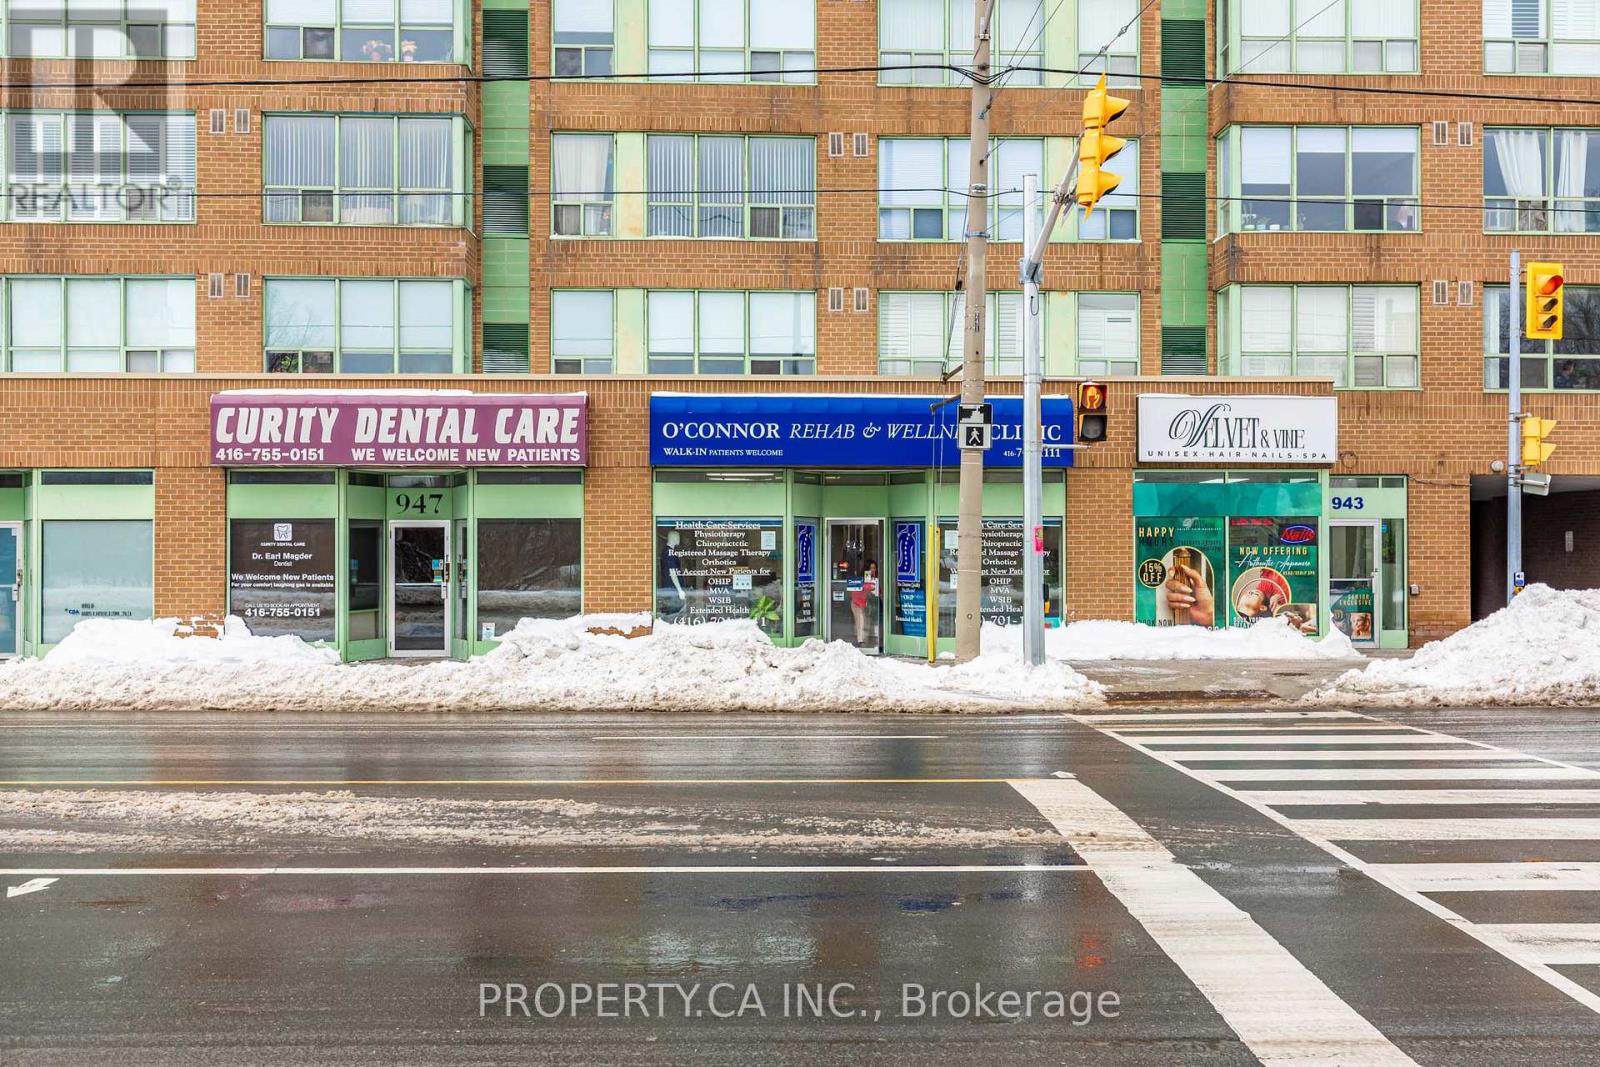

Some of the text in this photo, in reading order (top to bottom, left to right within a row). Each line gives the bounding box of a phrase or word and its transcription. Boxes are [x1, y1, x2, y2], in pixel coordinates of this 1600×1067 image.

[216, 407, 580, 444] CURITY DENTAL CARE
[1168, 403, 1305, 449] VELVET & VINE
[662, 421, 1061, 440] O'CONNOR REHAB & WELLN CLIIC
[216, 448, 324, 461] 416-755-0151
[351, 448, 581, 461] WE WELCOME NEW PATIENTS
[663, 447, 707, 456] WALK-IN
[395, 494, 443, 514] 947
[1331, 496, 1364, 510] 943
[694, 530, 746, 539] Physiotherapy
[1138, 526, 1175, 538] HAPPY
[668, 549, 771, 557] Registered Massage Therapy
[988, 549, 1019, 557] Massage
[1239, 546, 1308, 555] NOW OFFERING
[282, 553, 313, 561] Magder
[982, 558, 1017, 566] Orthotics
[709, 568, 728, 576] New
[990, 568, 1007, 576] New
[1144, 562, 1163, 573] 15%
[989, 577, 1012, 585] OHIP
[1142, 572, 1162, 582] OFF
[245, 608, 320, 617] 416-755-0151
[690, 606, 750, 614] Extended Health
